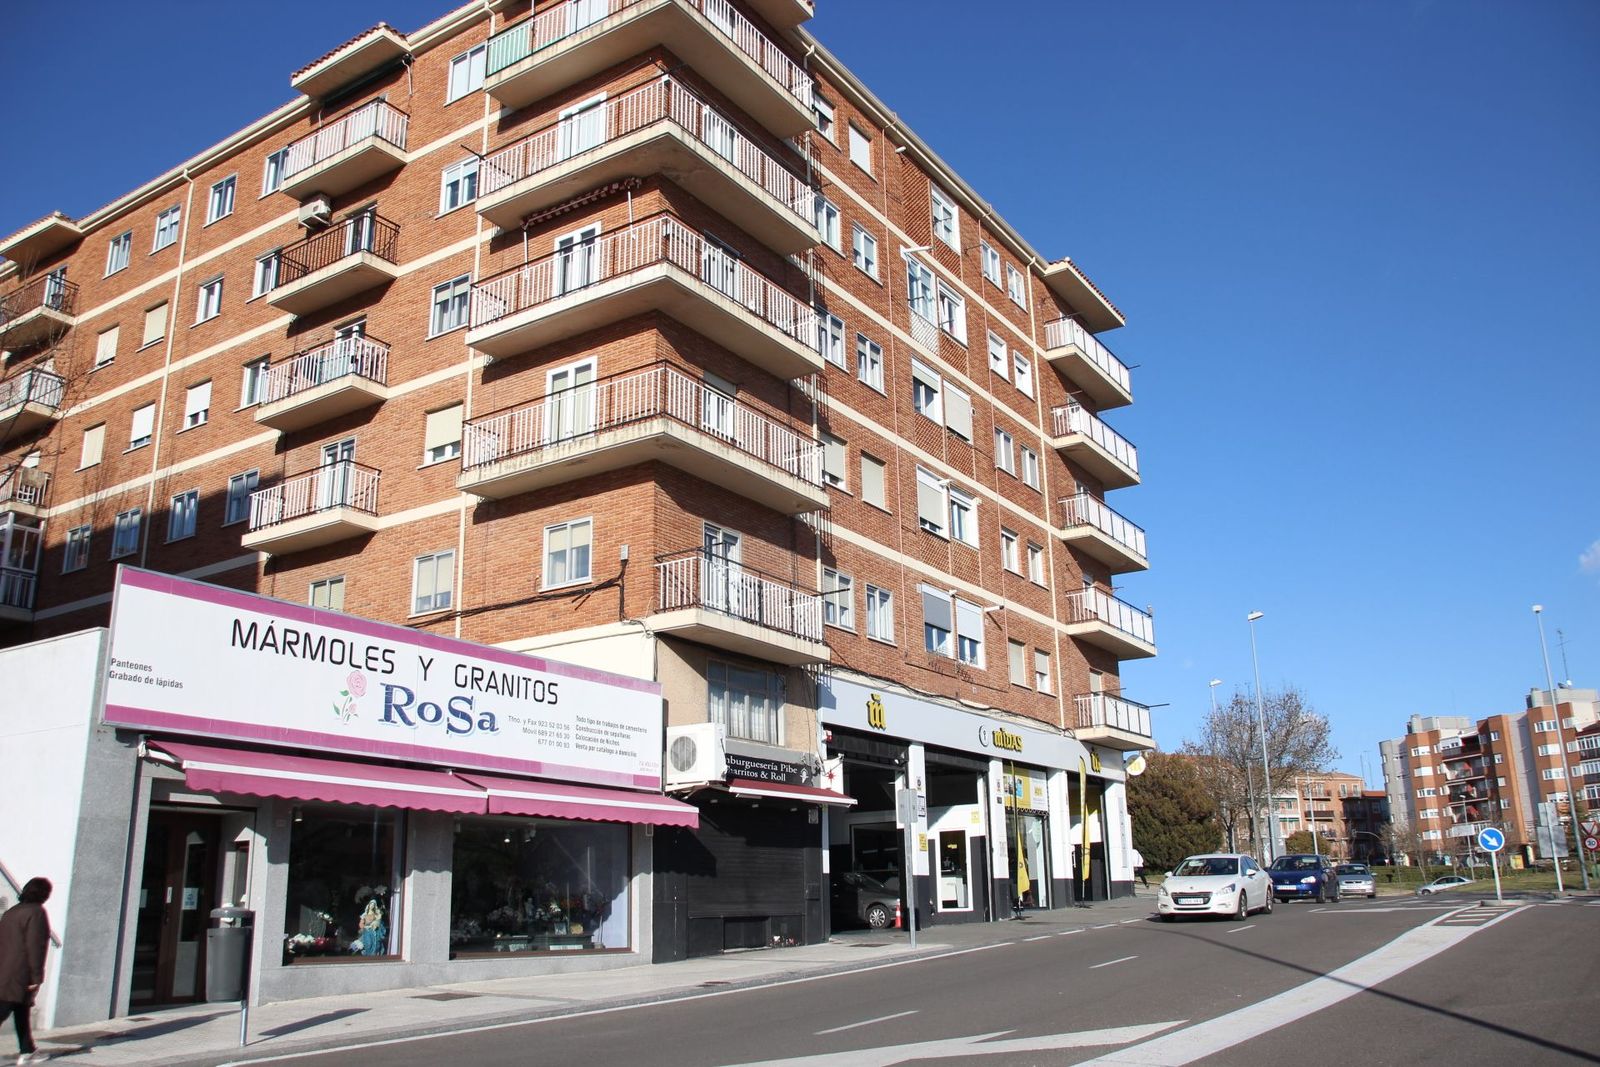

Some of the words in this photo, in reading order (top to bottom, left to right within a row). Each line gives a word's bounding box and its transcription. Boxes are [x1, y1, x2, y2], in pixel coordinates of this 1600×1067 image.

[110, 657, 153, 672] Panteones
[231, 618, 396, 674] MÁRMOLES
[418, 655, 434, 682] Y
[454, 664, 559, 705] GRANITOS
[109, 670, 143, 683] Grabado
[144, 675, 154, 685] de
[527, 718, 537, 726] Fax
[780, 763, 798, 774] Pibe
[760, 770, 769, 780] &
[771, 771, 786, 782] Roll
